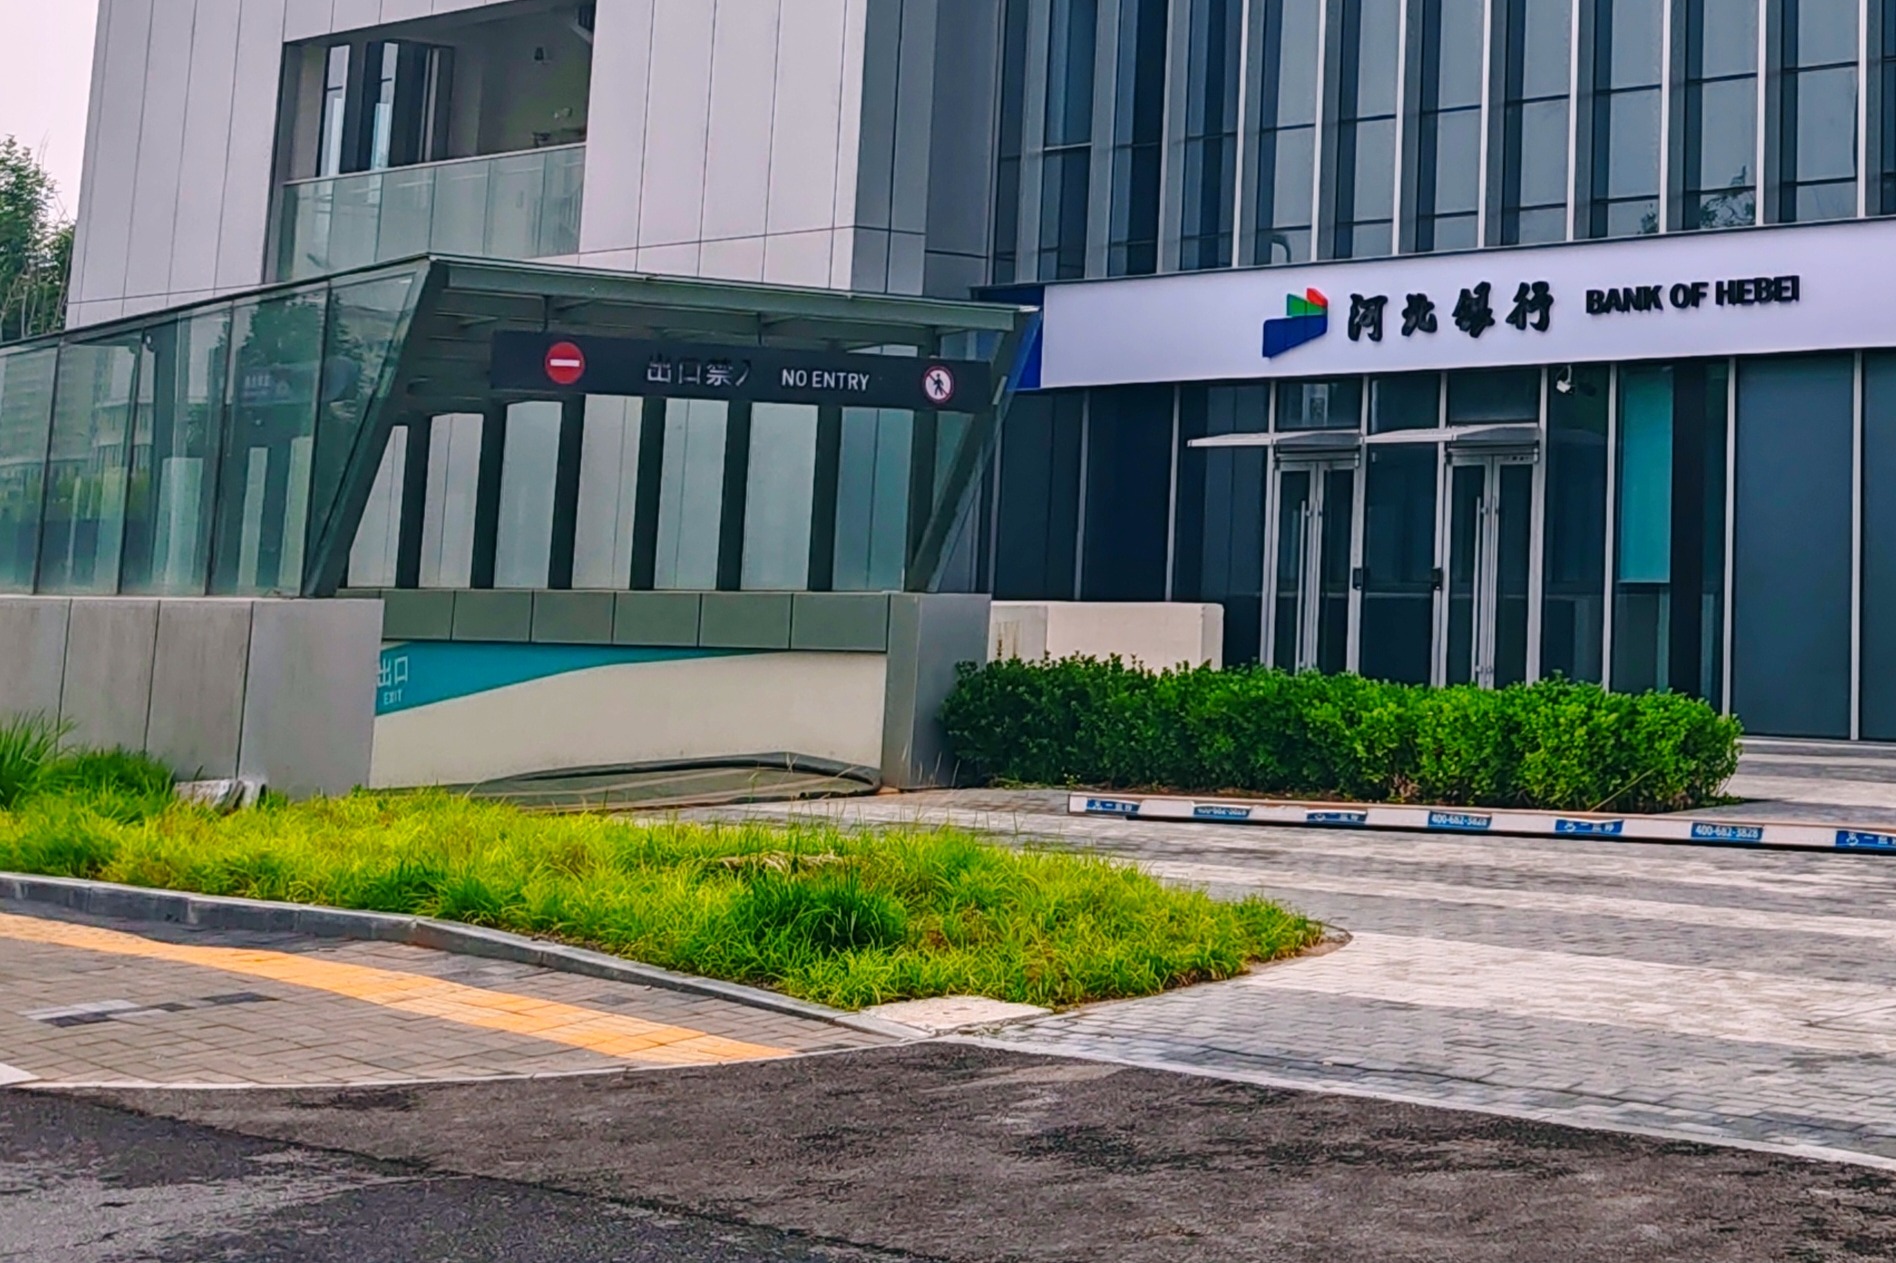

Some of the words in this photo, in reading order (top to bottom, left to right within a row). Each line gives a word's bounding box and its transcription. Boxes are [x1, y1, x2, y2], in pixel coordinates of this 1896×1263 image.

[1586, 285, 1664, 315] BANK
[1669, 281, 1710, 310] OF
[1715, 275, 1800, 307] HEBEI
[782, 368, 807, 387] NO
[811, 370, 870, 391] ENTRY
[383, 688, 402, 705] EXIT
